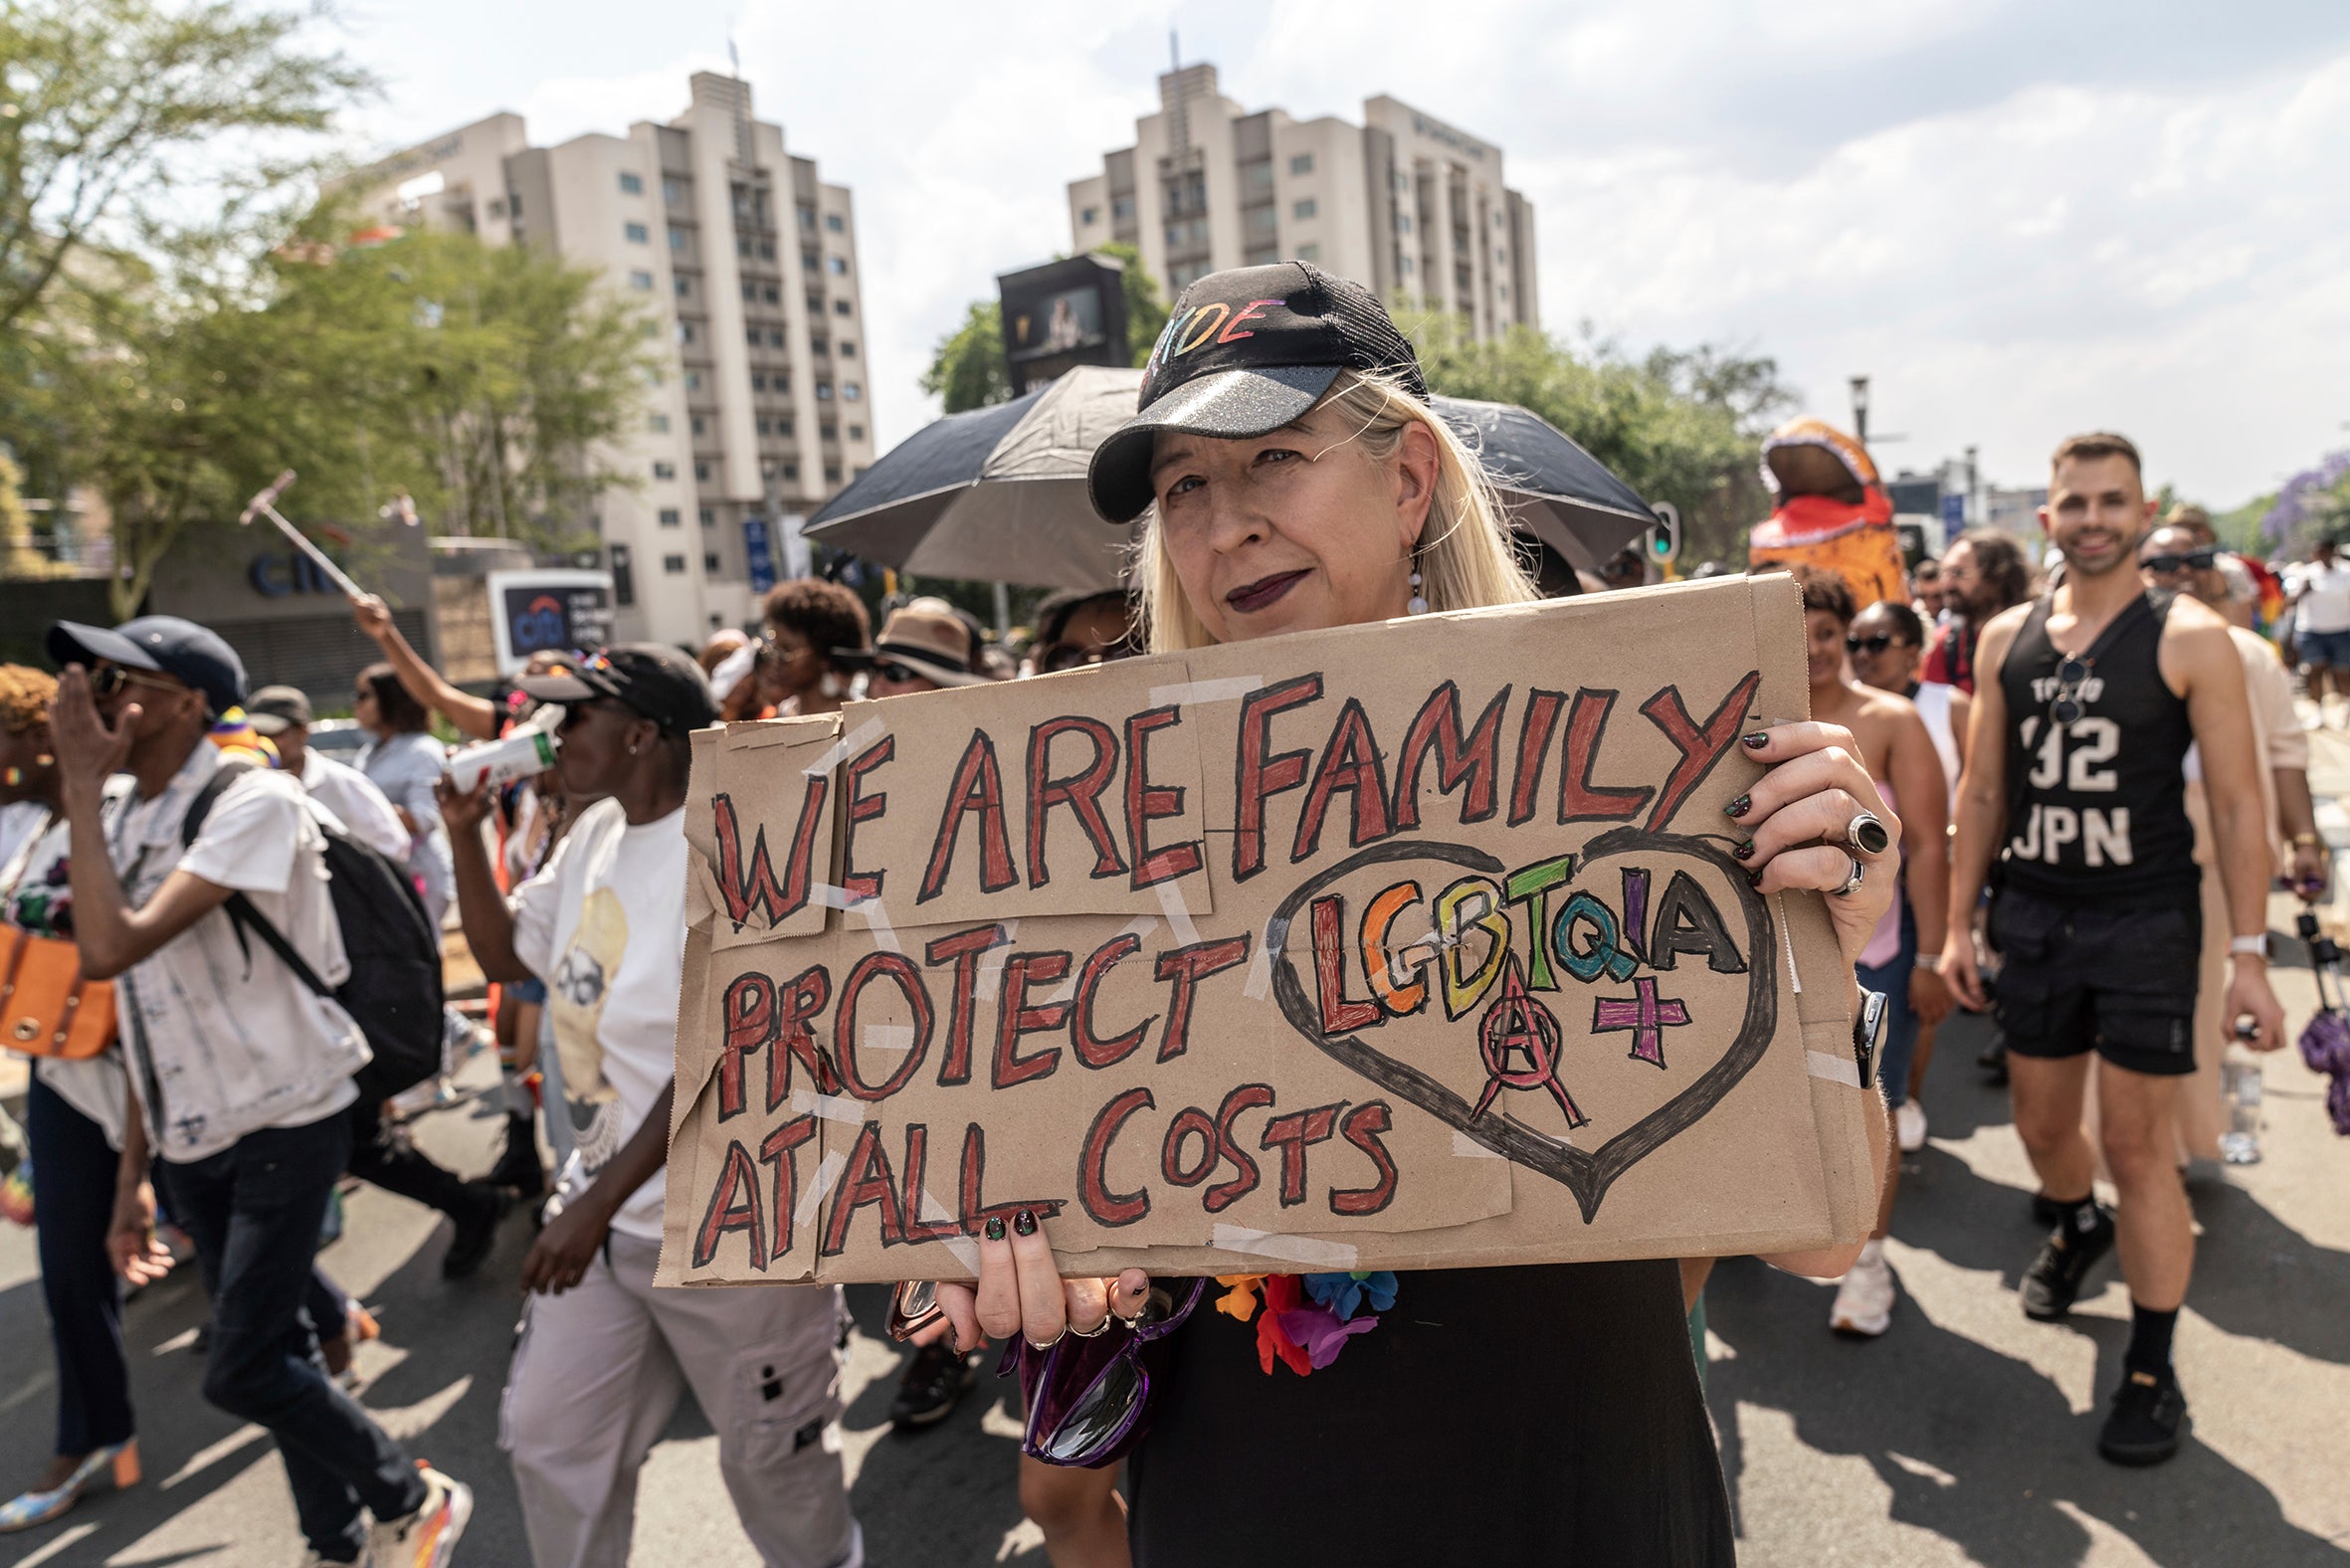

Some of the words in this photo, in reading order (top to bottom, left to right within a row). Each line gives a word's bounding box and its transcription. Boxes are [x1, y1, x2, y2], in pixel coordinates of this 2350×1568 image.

[1143, 299, 1286, 380] IDE
[714, 733, 895, 932] WE
[916, 703, 1204, 905] ARE
[1233, 670, 1761, 882] FAMILY
[2012, 803, 2134, 868] JPN
[717, 922, 1252, 1123] PROTECT
[1310, 855, 1748, 1038] LGBTQIA
[692, 1111, 818, 1272] AT
[820, 1120, 1068, 1257] ALL
